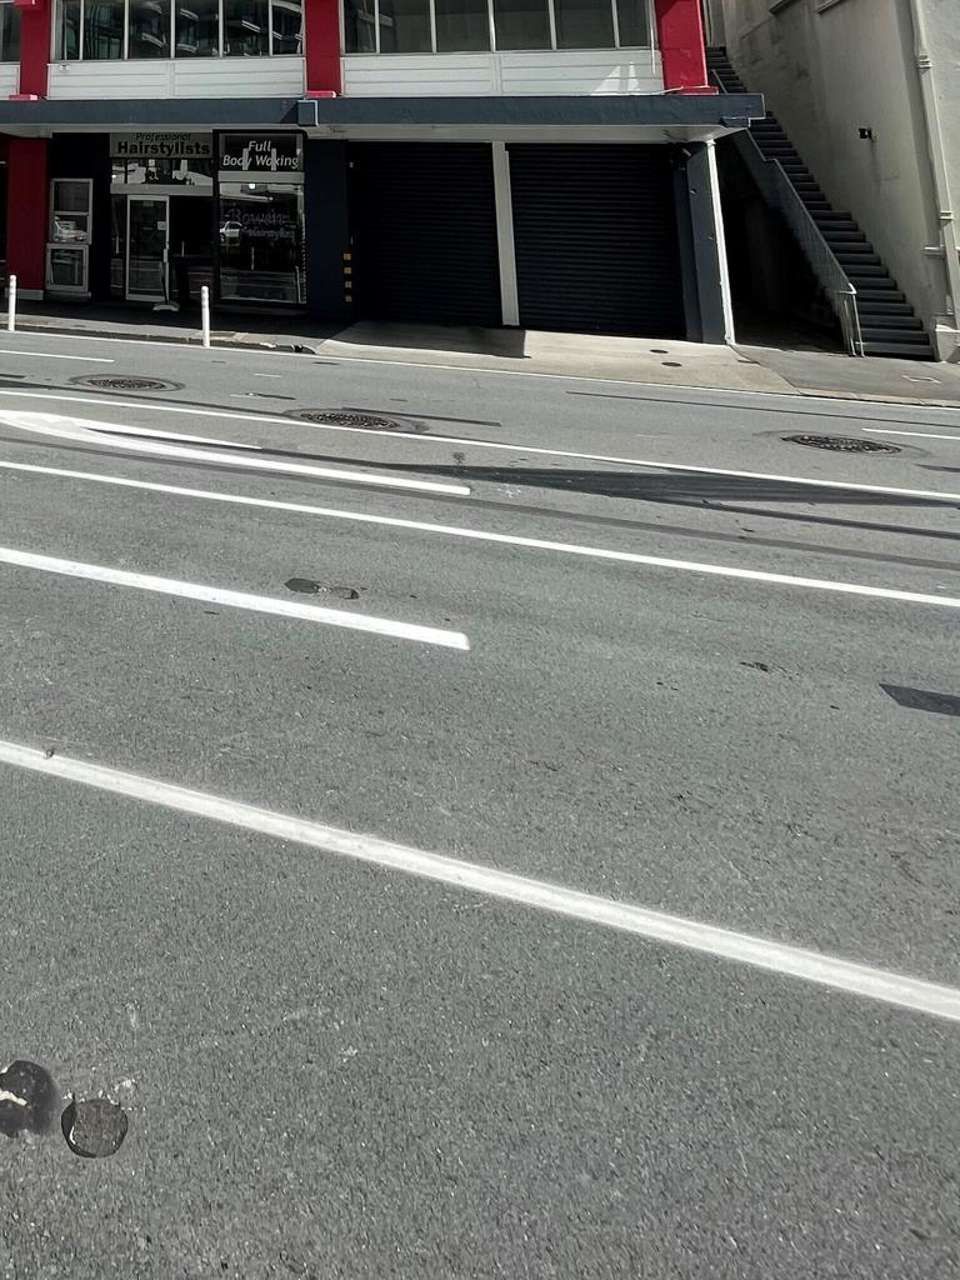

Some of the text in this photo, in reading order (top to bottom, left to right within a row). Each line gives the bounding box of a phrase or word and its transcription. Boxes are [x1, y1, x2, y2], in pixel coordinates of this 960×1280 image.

[117, 141, 210, 156] Hairstylists
[248, 140, 271, 152] Full
[223, 154, 298, 169] Body Waxing
